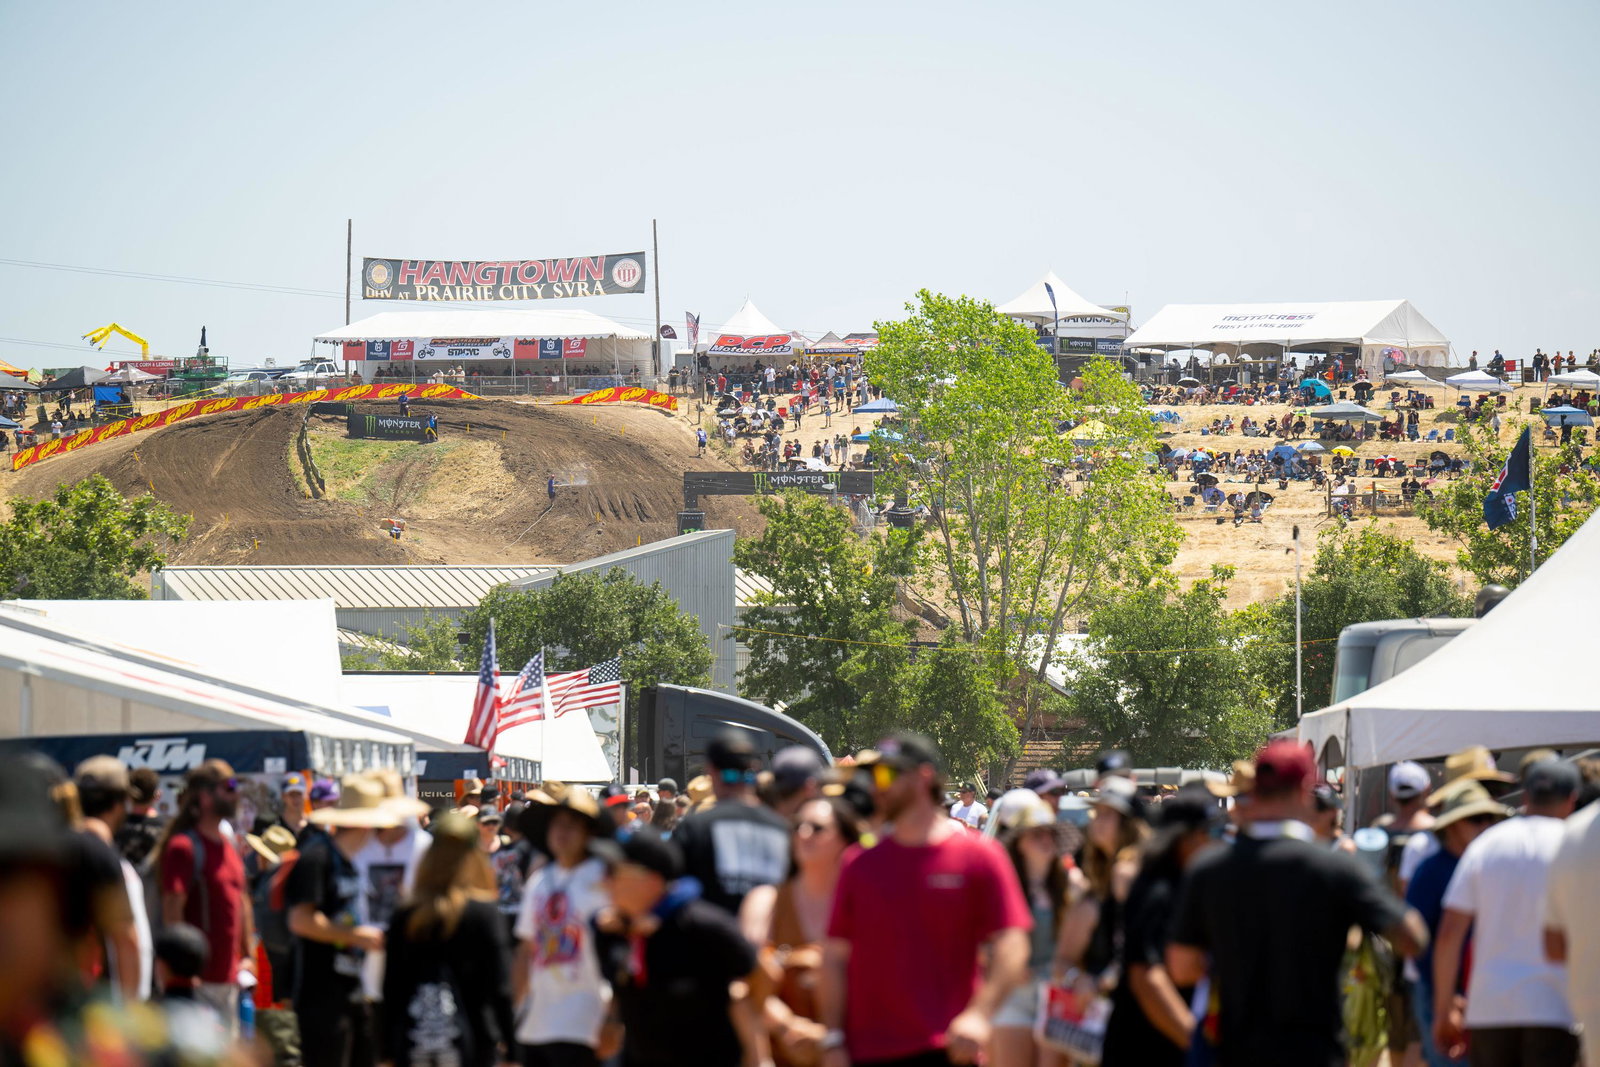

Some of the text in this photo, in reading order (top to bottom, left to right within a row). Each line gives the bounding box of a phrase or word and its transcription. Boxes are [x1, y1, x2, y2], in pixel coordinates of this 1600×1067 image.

[398, 256, 606, 285] HANGTOWN
[398, 292, 410, 300] AT
[414, 285, 494, 300] PRAIRIE
[498, 284, 546, 300] CITY
[553, 281, 607, 298] SVRA
[1222, 313, 1316, 321] MOTOCROSS
[447, 348, 480, 356] STACYC
[709, 345, 791, 354] Motorsports
[334, 384, 373, 400] FMF
[378, 384, 416, 398] FMF
[421, 384, 454, 398] FMF
[582, 387, 614, 404] FMF
[620, 387, 647, 401] FMF
[201, 398, 236, 414] FMF
[243, 394, 282, 409] FMF
[166, 402, 195, 425] FMF
[98, 420, 126, 442] FMF
[131, 413, 160, 433] FMF
[379, 418, 421, 429] MONSTER
[67, 429, 93, 450] FMF
[38, 438, 62, 459] FMF
[14, 447, 35, 470] FMF
[771, 475, 825, 484] MONSTER
[117, 737, 207, 770] KTM
